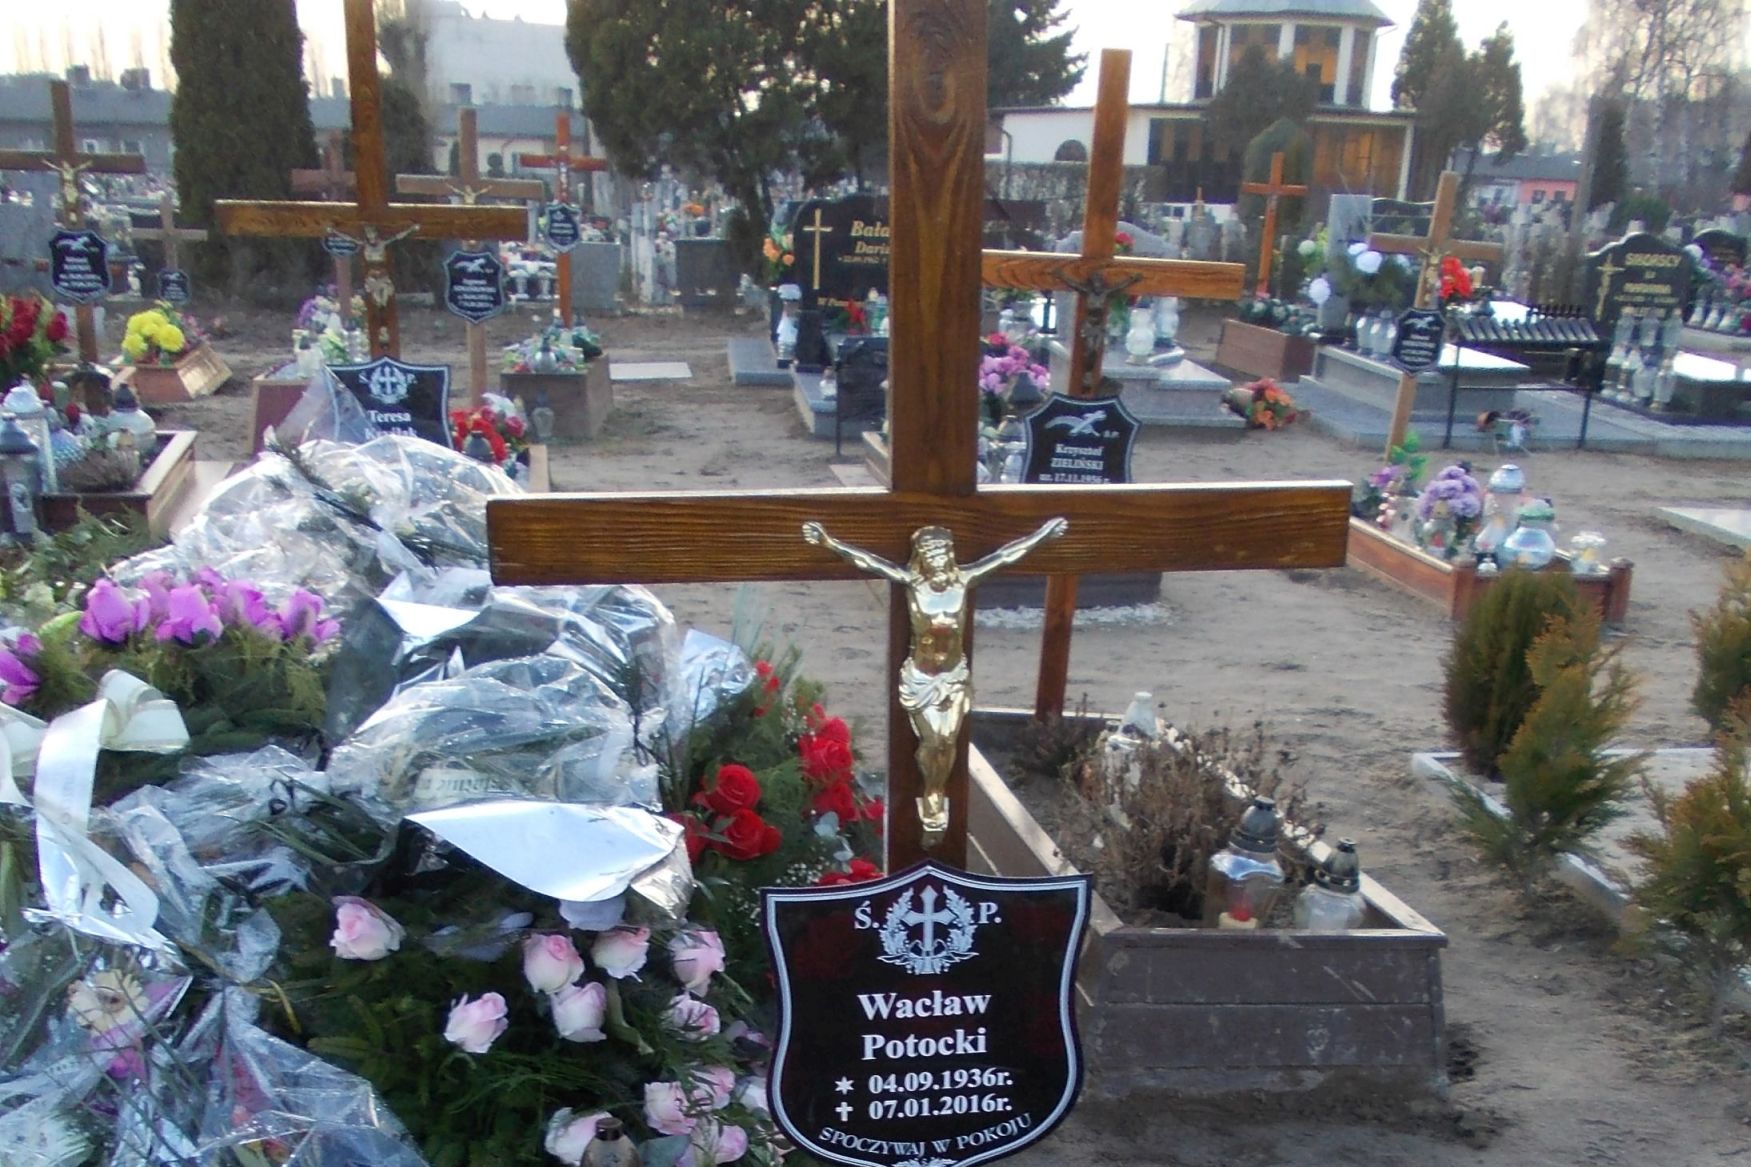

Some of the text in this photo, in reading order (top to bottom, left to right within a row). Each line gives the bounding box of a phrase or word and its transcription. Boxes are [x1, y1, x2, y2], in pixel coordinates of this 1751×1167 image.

[850, 219, 891, 237] Bała
[368, 409, 411, 422] Teresa
[1055, 443, 1105, 457] Krzysztof
[978, 902, 1002, 925] P.
[857, 990, 992, 1021] Wacław
[861, 1027, 988, 1060] Potocki
[868, 1067, 1013, 1094] 04.09.1936r.
[868, 1093, 1013, 1120] 07.01.2016r.
[818, 1112, 1033, 1156] SPOCZYWAJ W POKOJU
